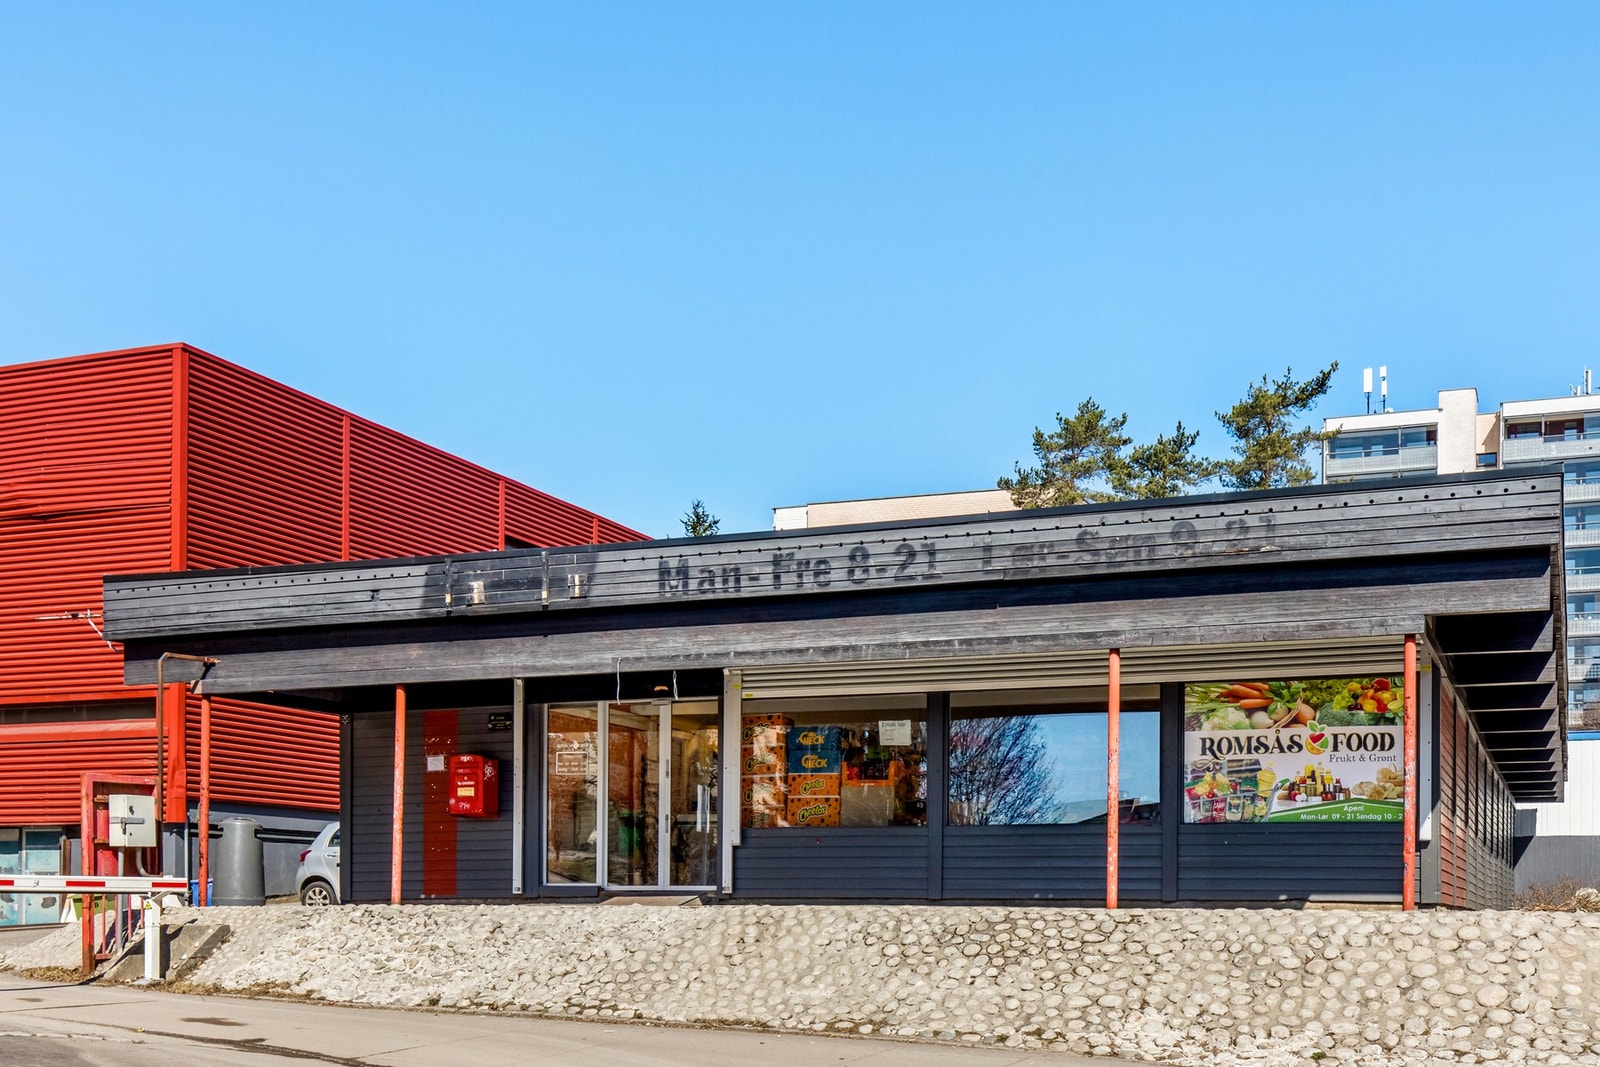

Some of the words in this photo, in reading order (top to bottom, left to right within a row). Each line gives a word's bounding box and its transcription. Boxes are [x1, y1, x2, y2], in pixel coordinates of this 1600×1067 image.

[1195, 729, 1304, 768] ROMSÅS
[1330, 731, 1396, 753] FOOD
[1328, 754, 1356, 763] Frukt
[1359, 754, 1366, 762] &
[1368, 753, 1397, 763] Grønt
[801, 779, 825, 795] Cheetos
[798, 805, 827, 823] Cheetos
